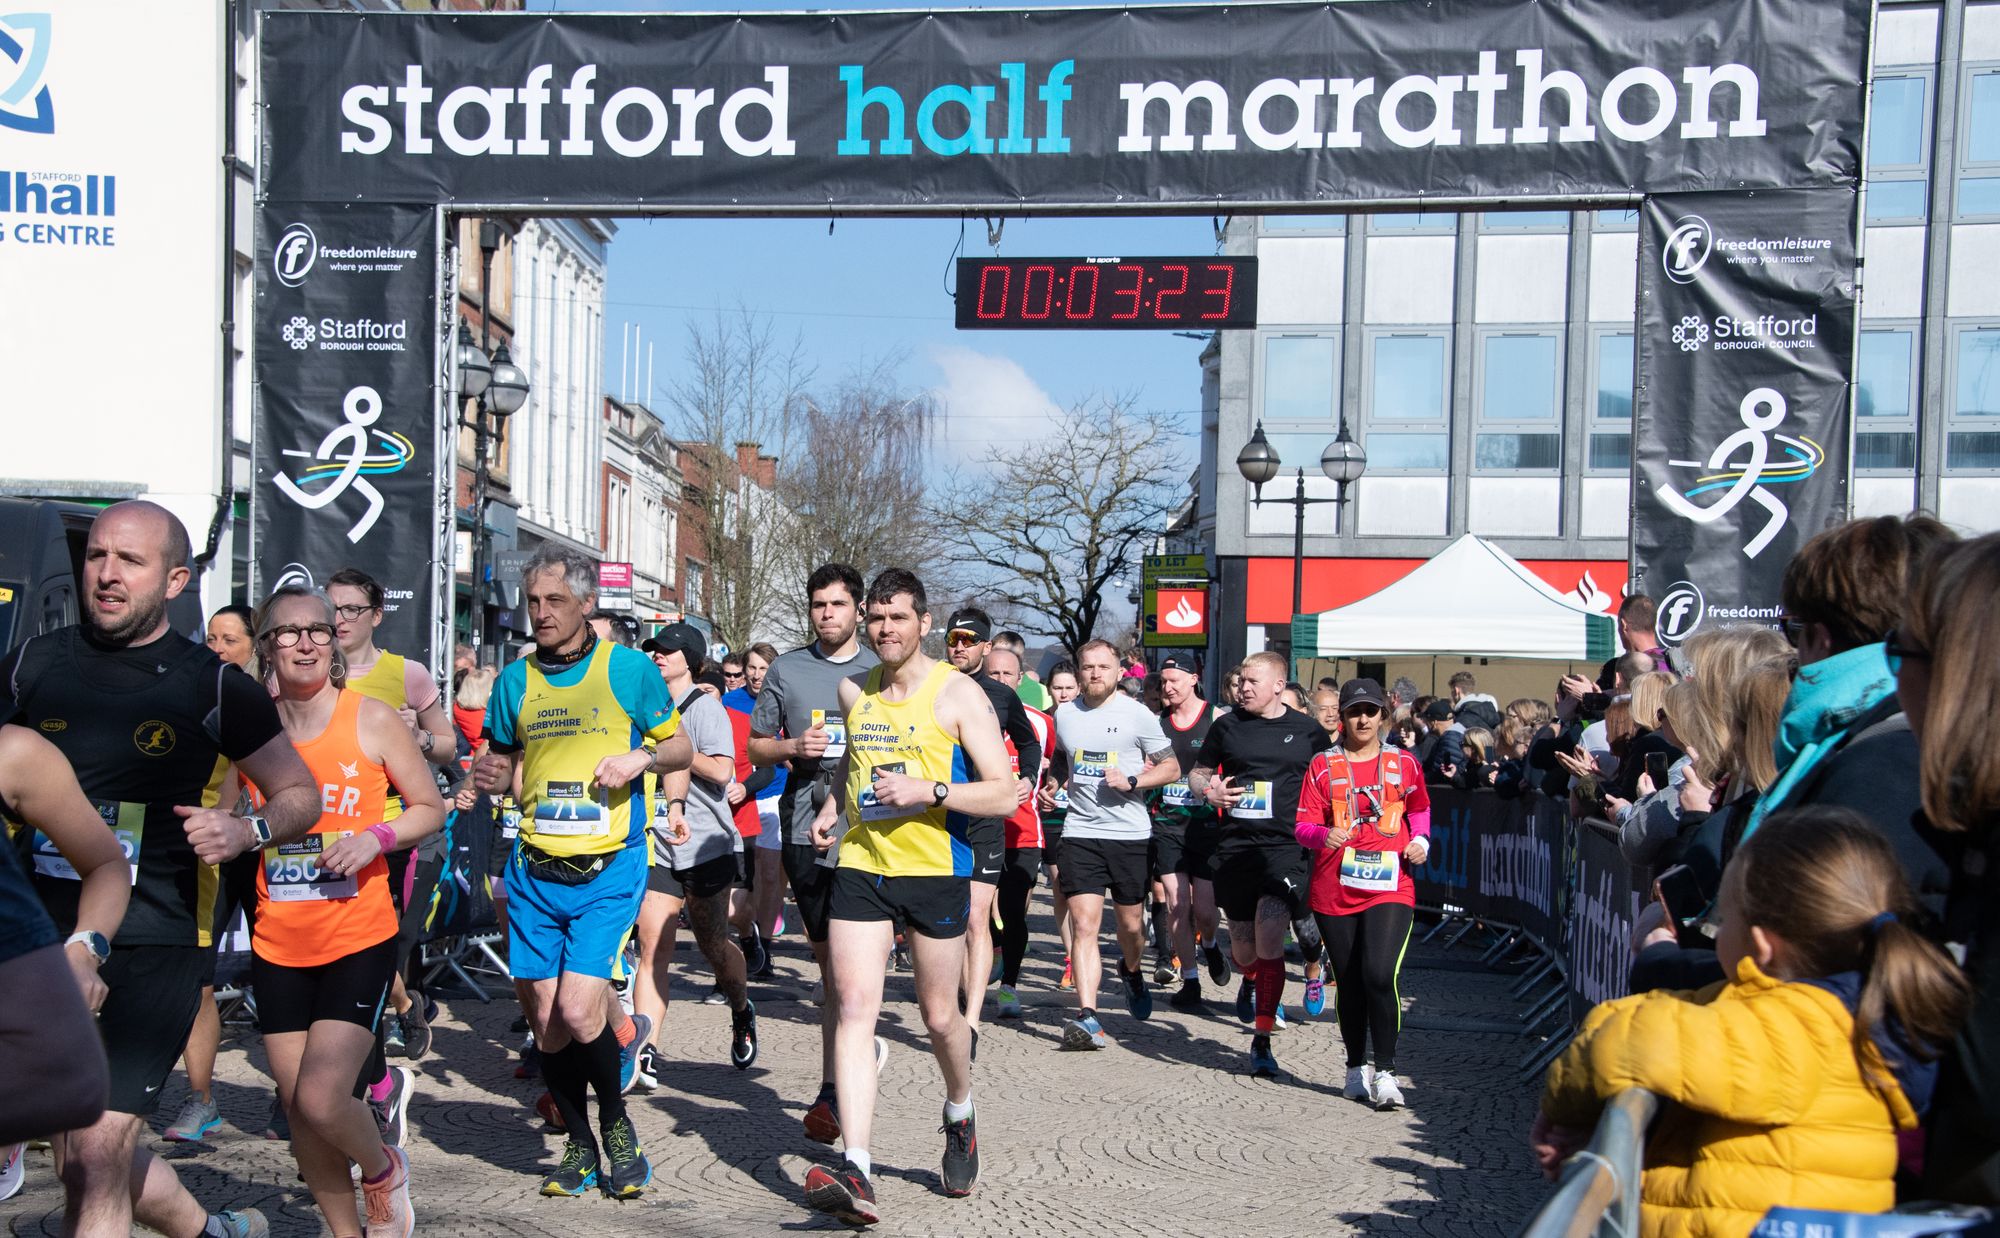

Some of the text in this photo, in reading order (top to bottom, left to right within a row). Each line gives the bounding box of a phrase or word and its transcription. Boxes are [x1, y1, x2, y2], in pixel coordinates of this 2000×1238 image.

[341, 48, 1767, 157] stafford half marathon
[31, 172, 82, 183] STAFFORD
[14, 223, 115, 246] CENTRE
[1716, 236, 1832, 251] freedomleisure
[320, 245, 418, 259] freedomleisure
[1726, 255, 1815, 266] where you matter
[329, 262, 404, 274] where you matter
[319, 318, 406, 339] Stafford
[1714, 314, 1816, 338] Stafford
[320, 342, 406, 351] BOROUGH COUNCIL
[1714, 339, 1815, 350] BOROUGH COUNCIL
[1146, 557, 1188, 568] TO LET
[1707, 604, 1783, 618] freedoml
[537, 707, 568, 718] SOUTH
[526, 718, 582, 733] DERBYSHIRE
[860, 723, 891, 732] SOUTH
[547, 730, 577, 738] RUNNERS
[851, 733, 900, 743] DERBYSHIRE
[551, 800, 579, 820] 71
[269, 856, 342, 884] 250
[1351, 863, 1384, 879] 187
